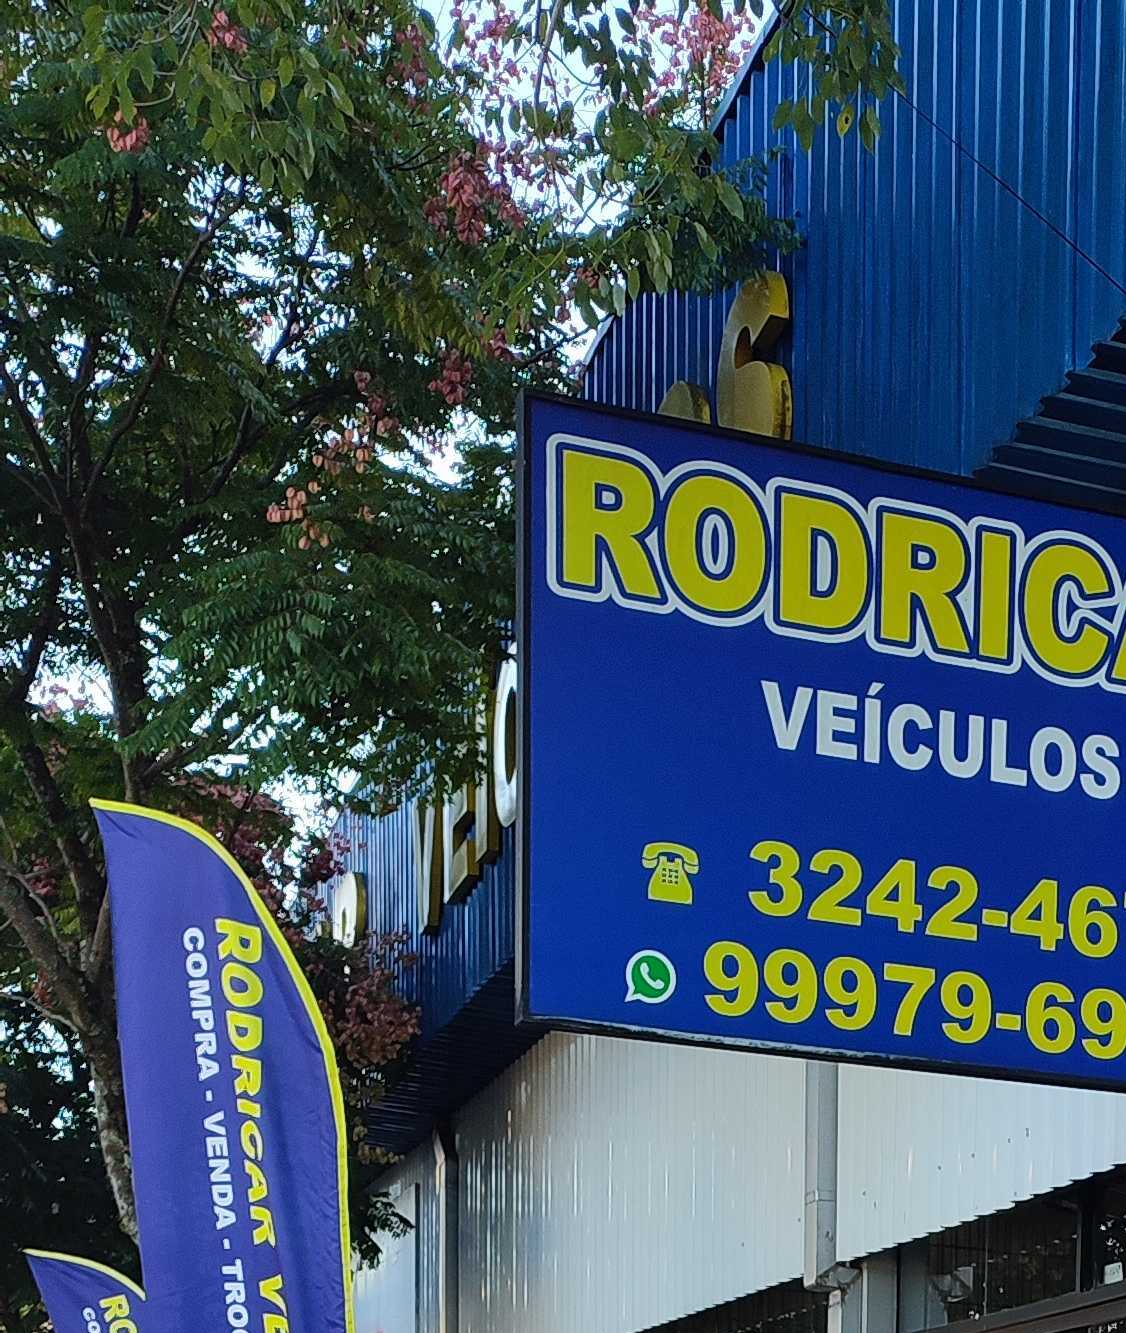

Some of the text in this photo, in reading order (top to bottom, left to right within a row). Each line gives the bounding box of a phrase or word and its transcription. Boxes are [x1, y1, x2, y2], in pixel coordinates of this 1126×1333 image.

[760, 680, 1121, 800] VEÍCULOS
[182, 926, 220, 1082] COMPRA
[202, 1110, 237, 1231] VENDA
[213, 917, 277, 1249] RODRICAR
